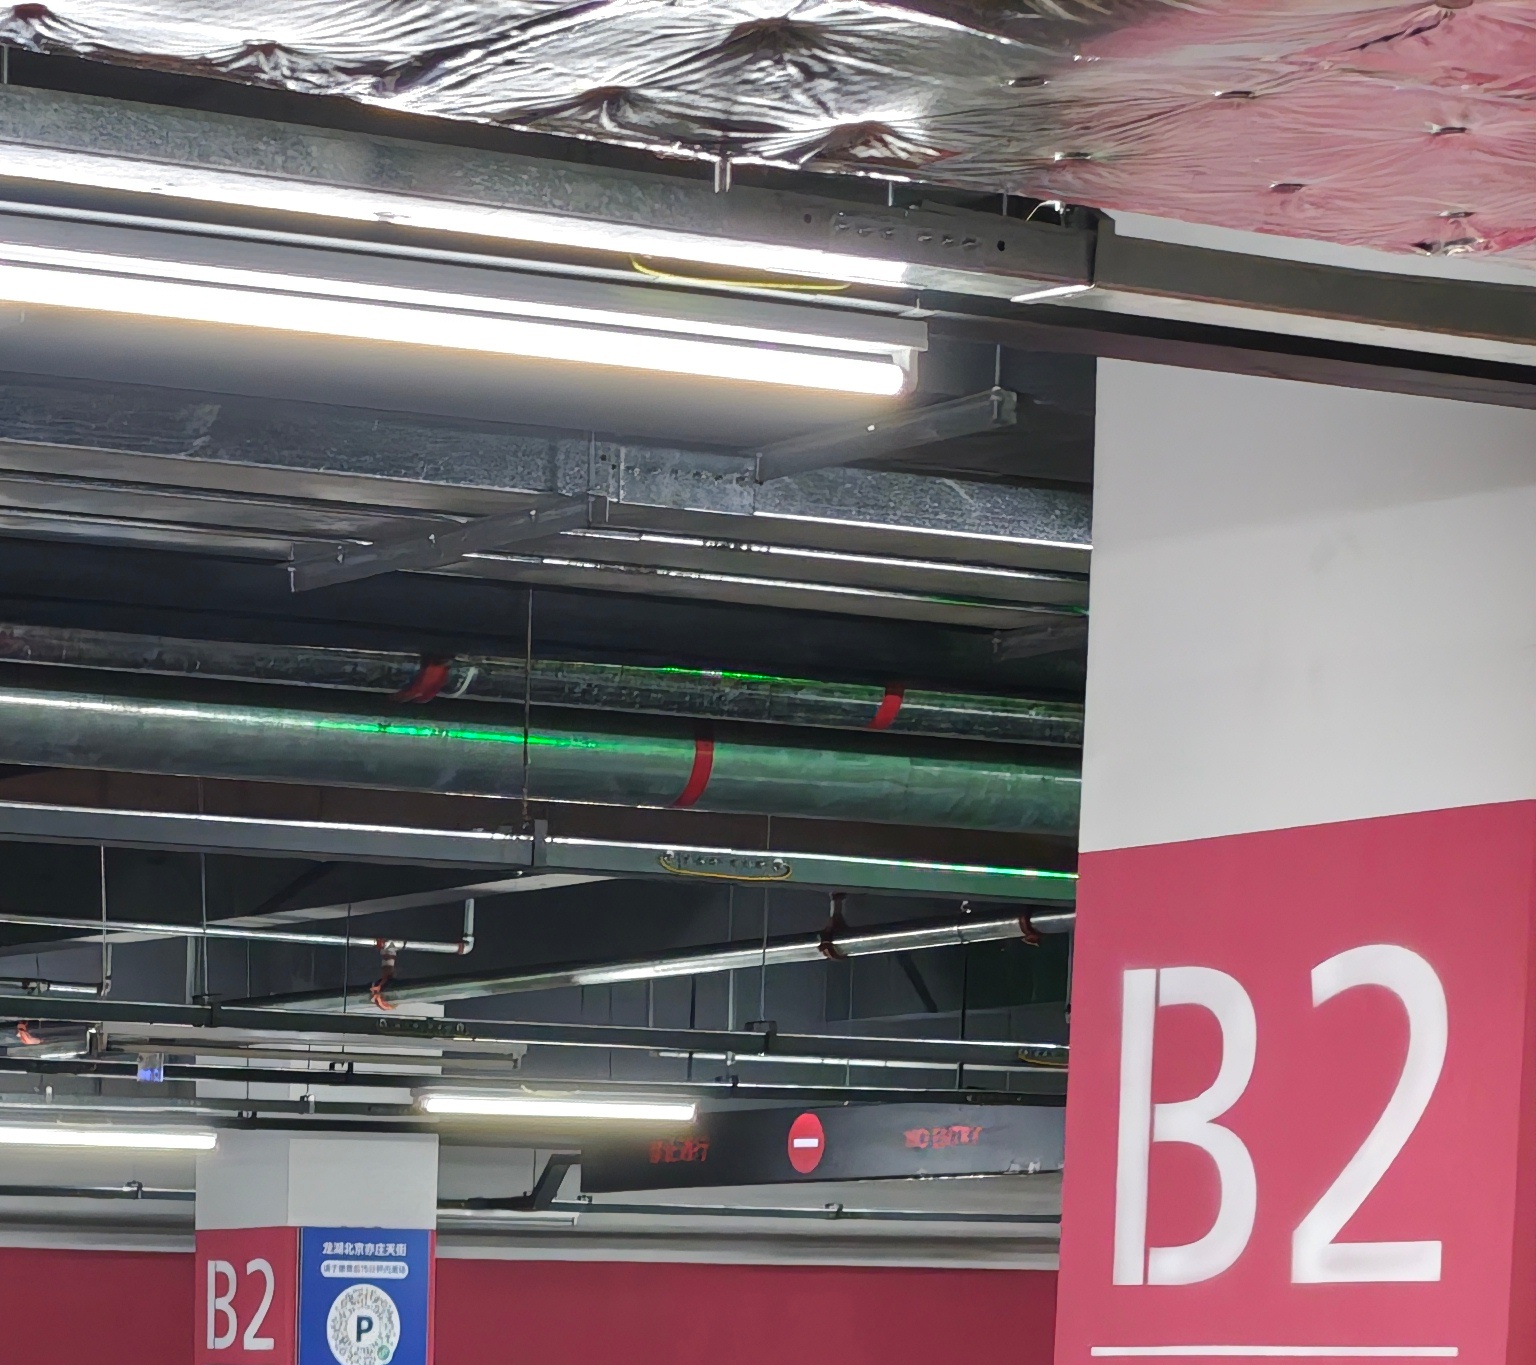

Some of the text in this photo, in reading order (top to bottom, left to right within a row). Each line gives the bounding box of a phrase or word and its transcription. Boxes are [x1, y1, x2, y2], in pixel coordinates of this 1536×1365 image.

[1113, 943, 1450, 1286] B2
[207, 1258, 274, 1350] B2
[356, 1316, 373, 1342] P
